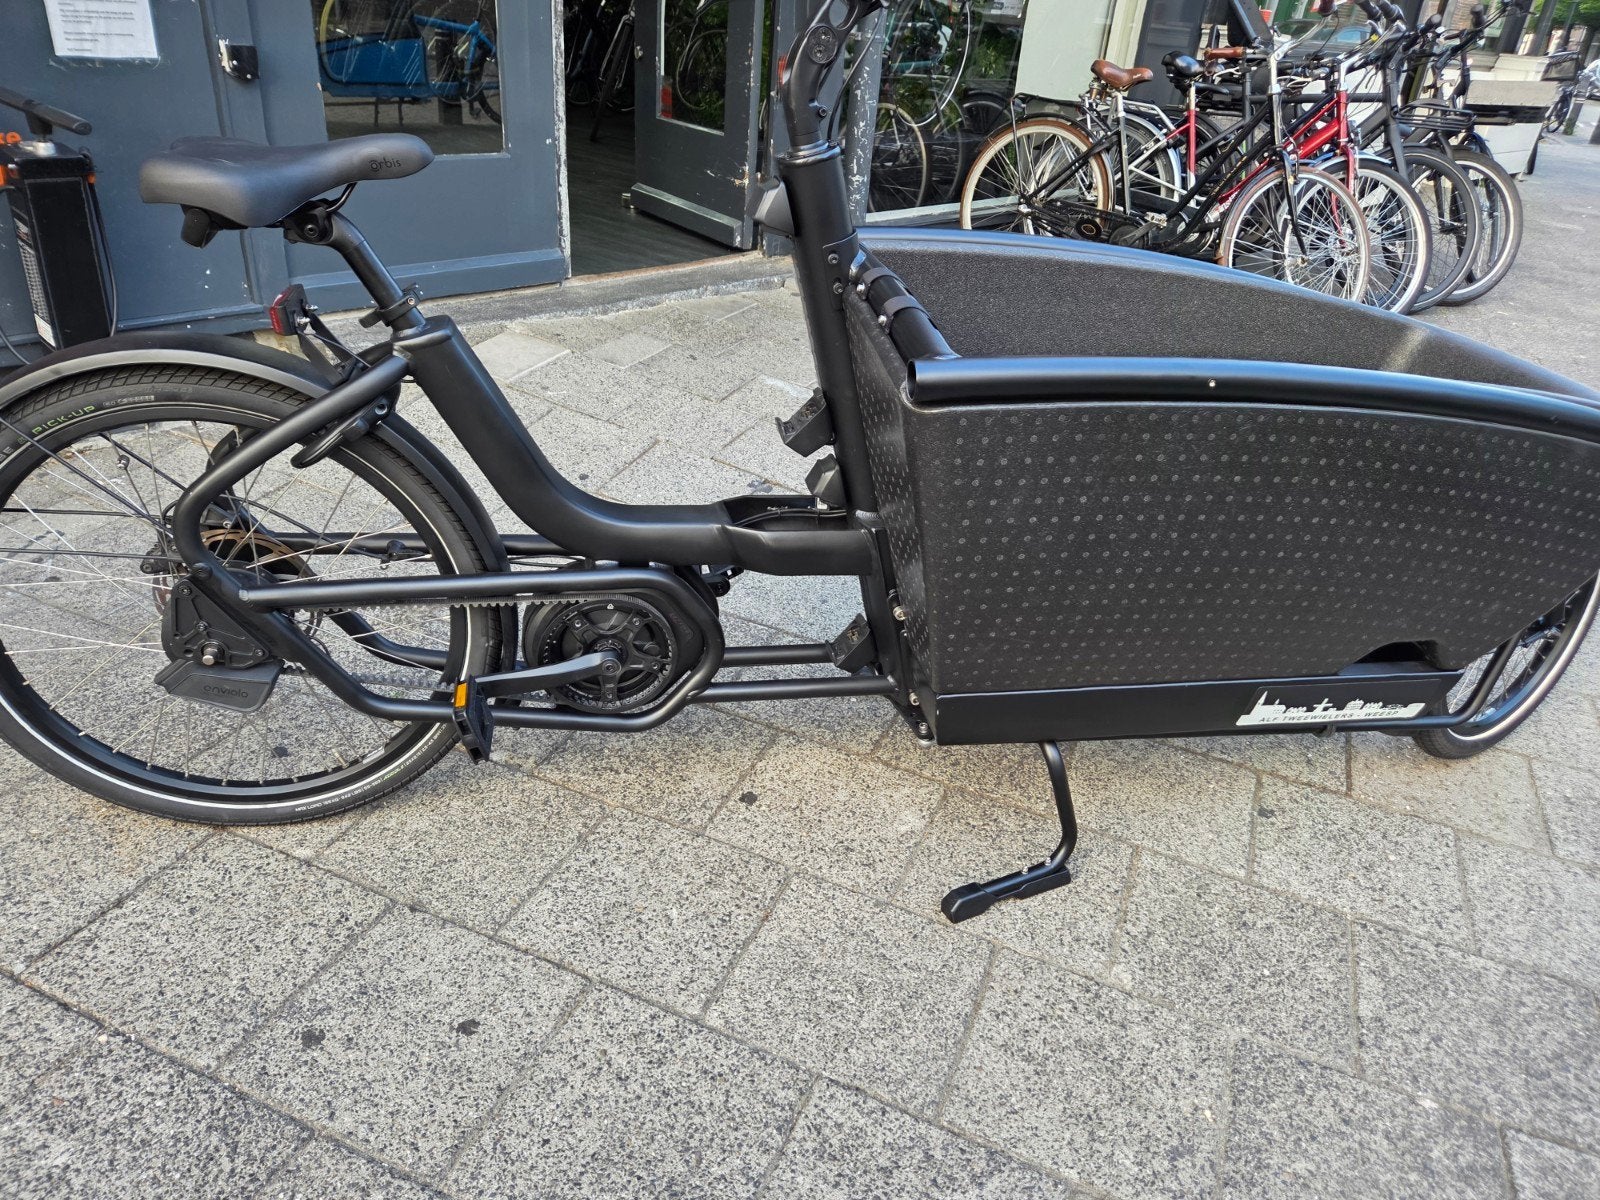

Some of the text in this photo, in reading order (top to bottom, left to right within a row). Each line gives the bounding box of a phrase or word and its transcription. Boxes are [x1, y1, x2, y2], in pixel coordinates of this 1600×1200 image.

[32, 404, 96, 434] PICK-UP
[203, 685, 249, 698] enviolo
[1364, 710, 1399, 718] WEESP
